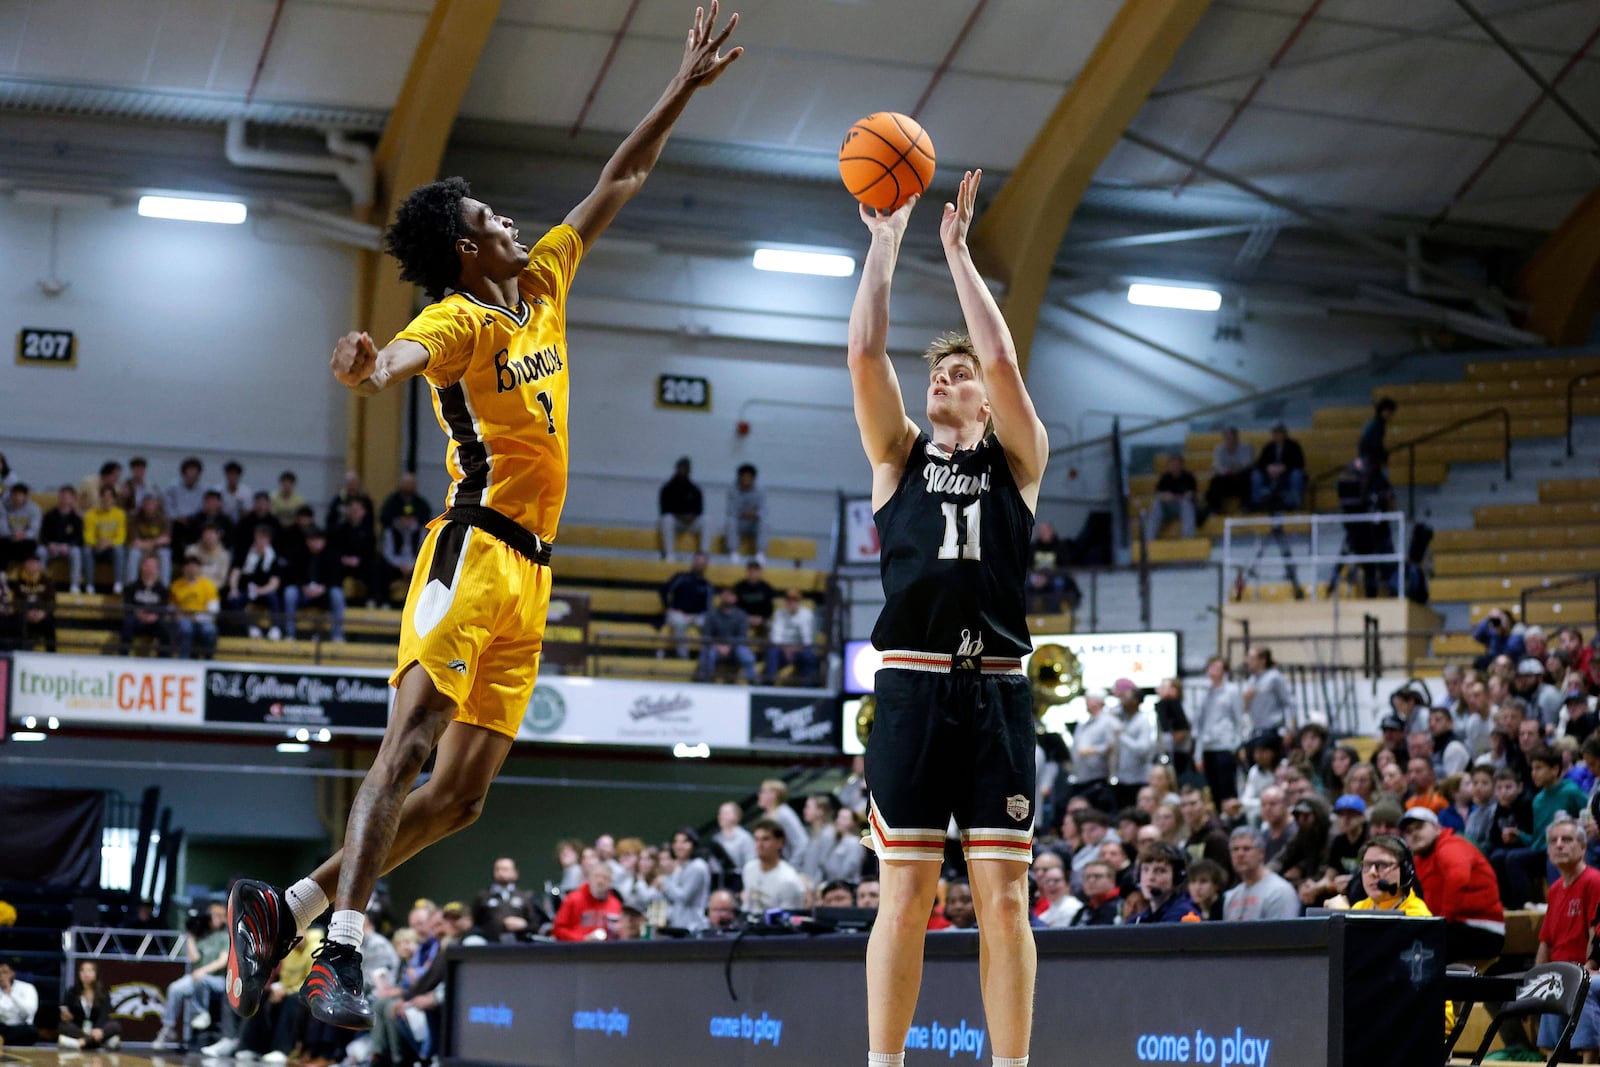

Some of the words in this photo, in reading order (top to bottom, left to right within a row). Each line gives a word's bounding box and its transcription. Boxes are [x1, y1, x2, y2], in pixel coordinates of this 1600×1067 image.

[25, 333, 70, 358] 207
[663, 379, 705, 404] 208
[938, 499, 981, 561] 11
[20, 670, 114, 701] tropical
[117, 672, 196, 713] CAFE
[710, 1016, 740, 1038] come
[741, 1012, 754, 1038] to
[754, 1011, 782, 1046] play
[932, 1021, 948, 1050] to
[949, 1019, 985, 1060] play
[1137, 1034, 1191, 1062] come
[1195, 1029, 1217, 1063] to
[1220, 1026, 1270, 1067] play
